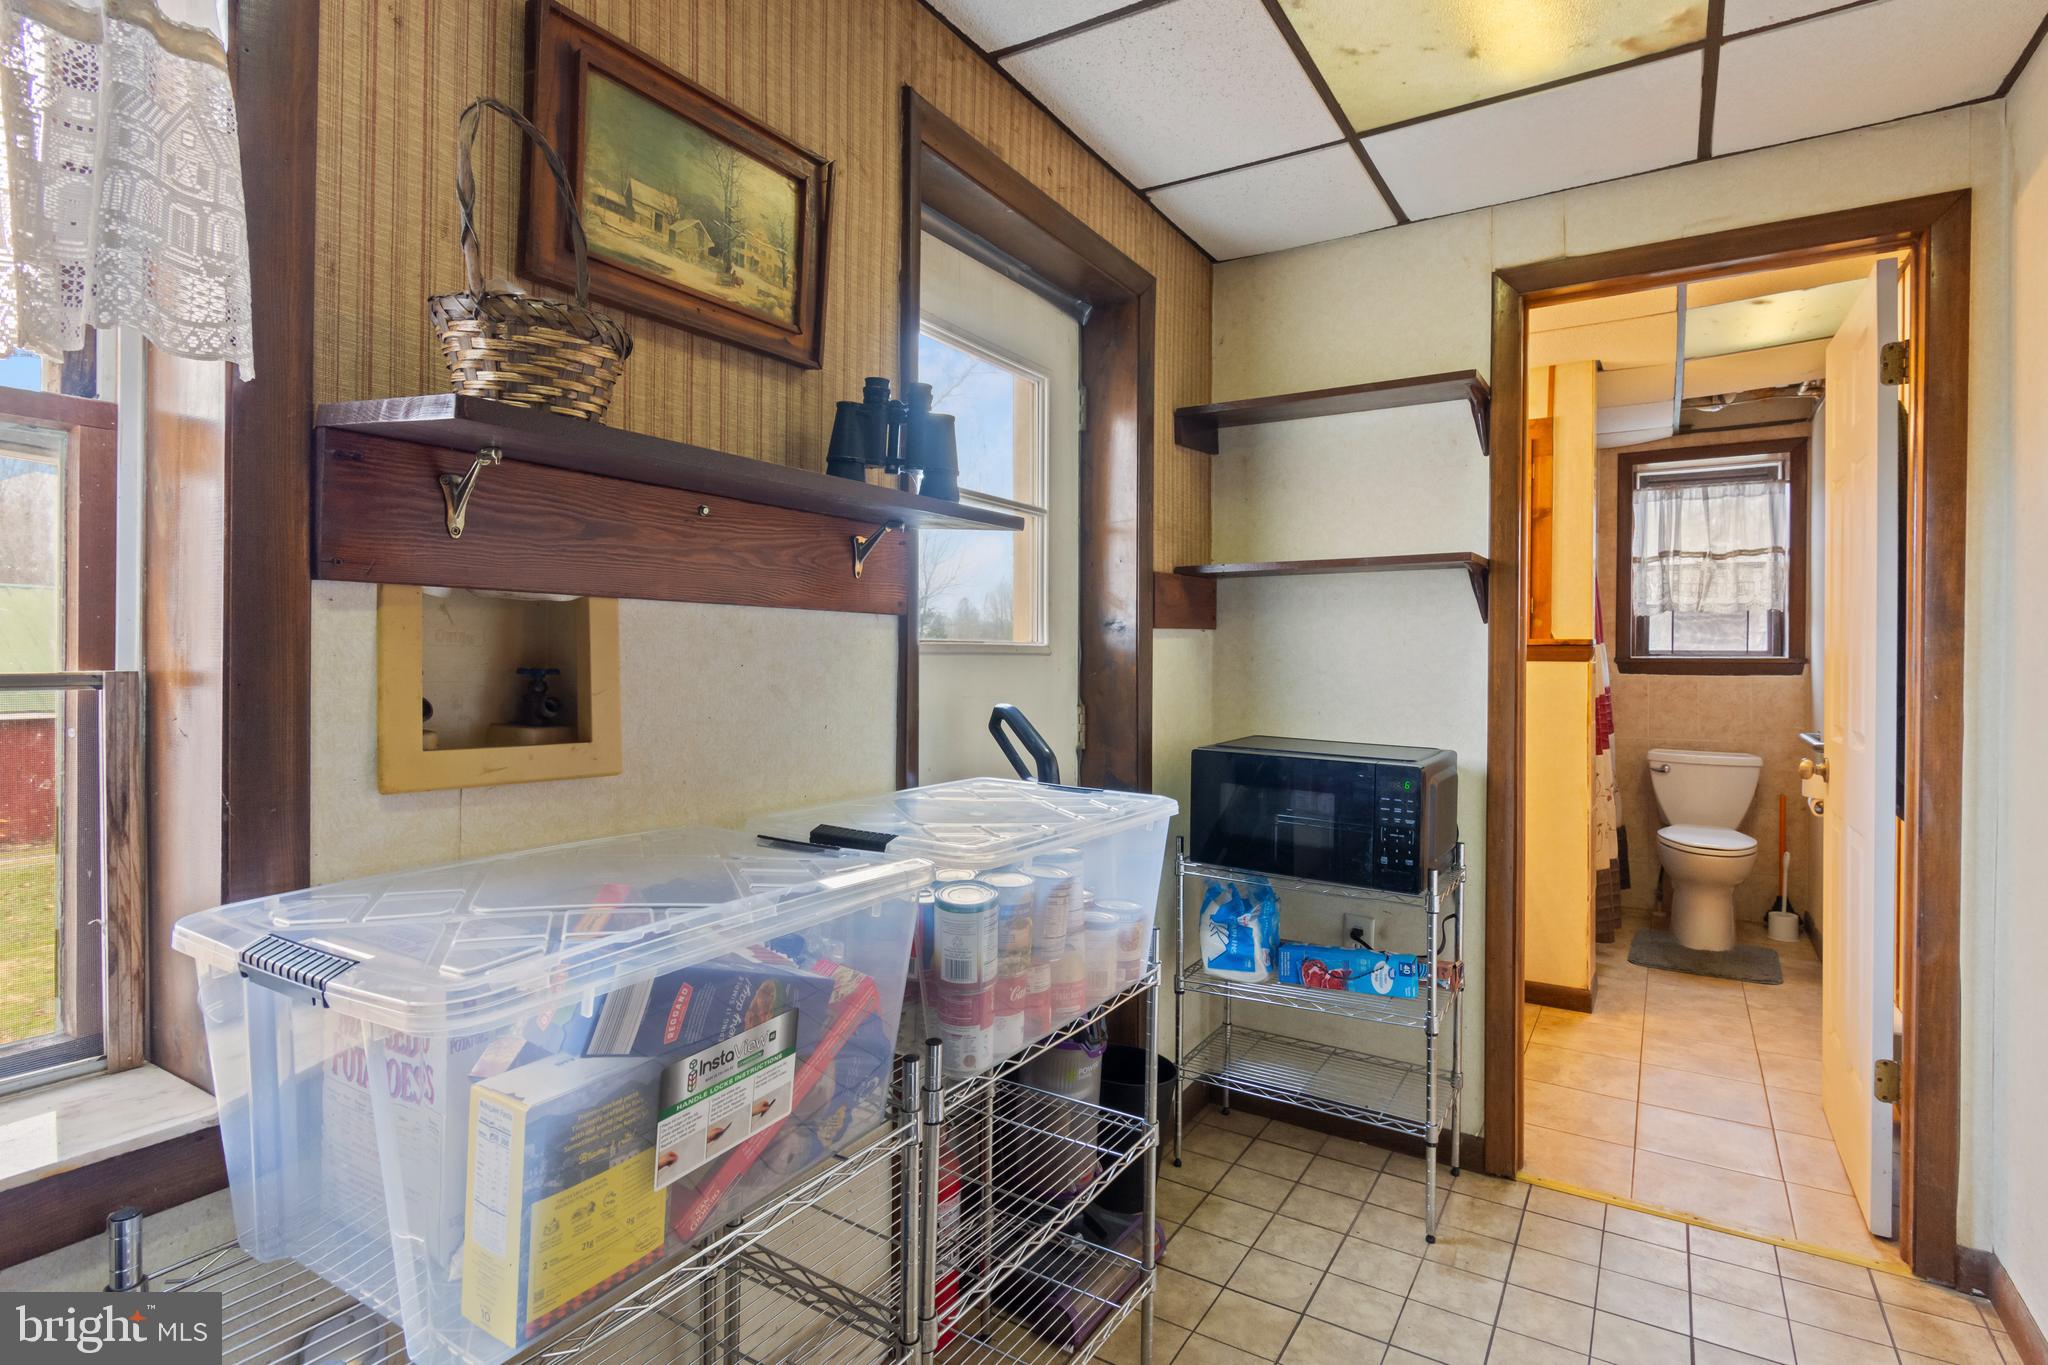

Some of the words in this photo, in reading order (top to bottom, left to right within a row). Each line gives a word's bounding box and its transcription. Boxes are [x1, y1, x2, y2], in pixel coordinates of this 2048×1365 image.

[676, 1089, 708, 1111] HANDLE
[710, 1077, 733, 1096] LOCKS
[735, 1053, 783, 1083] INSTRUCTIONS
